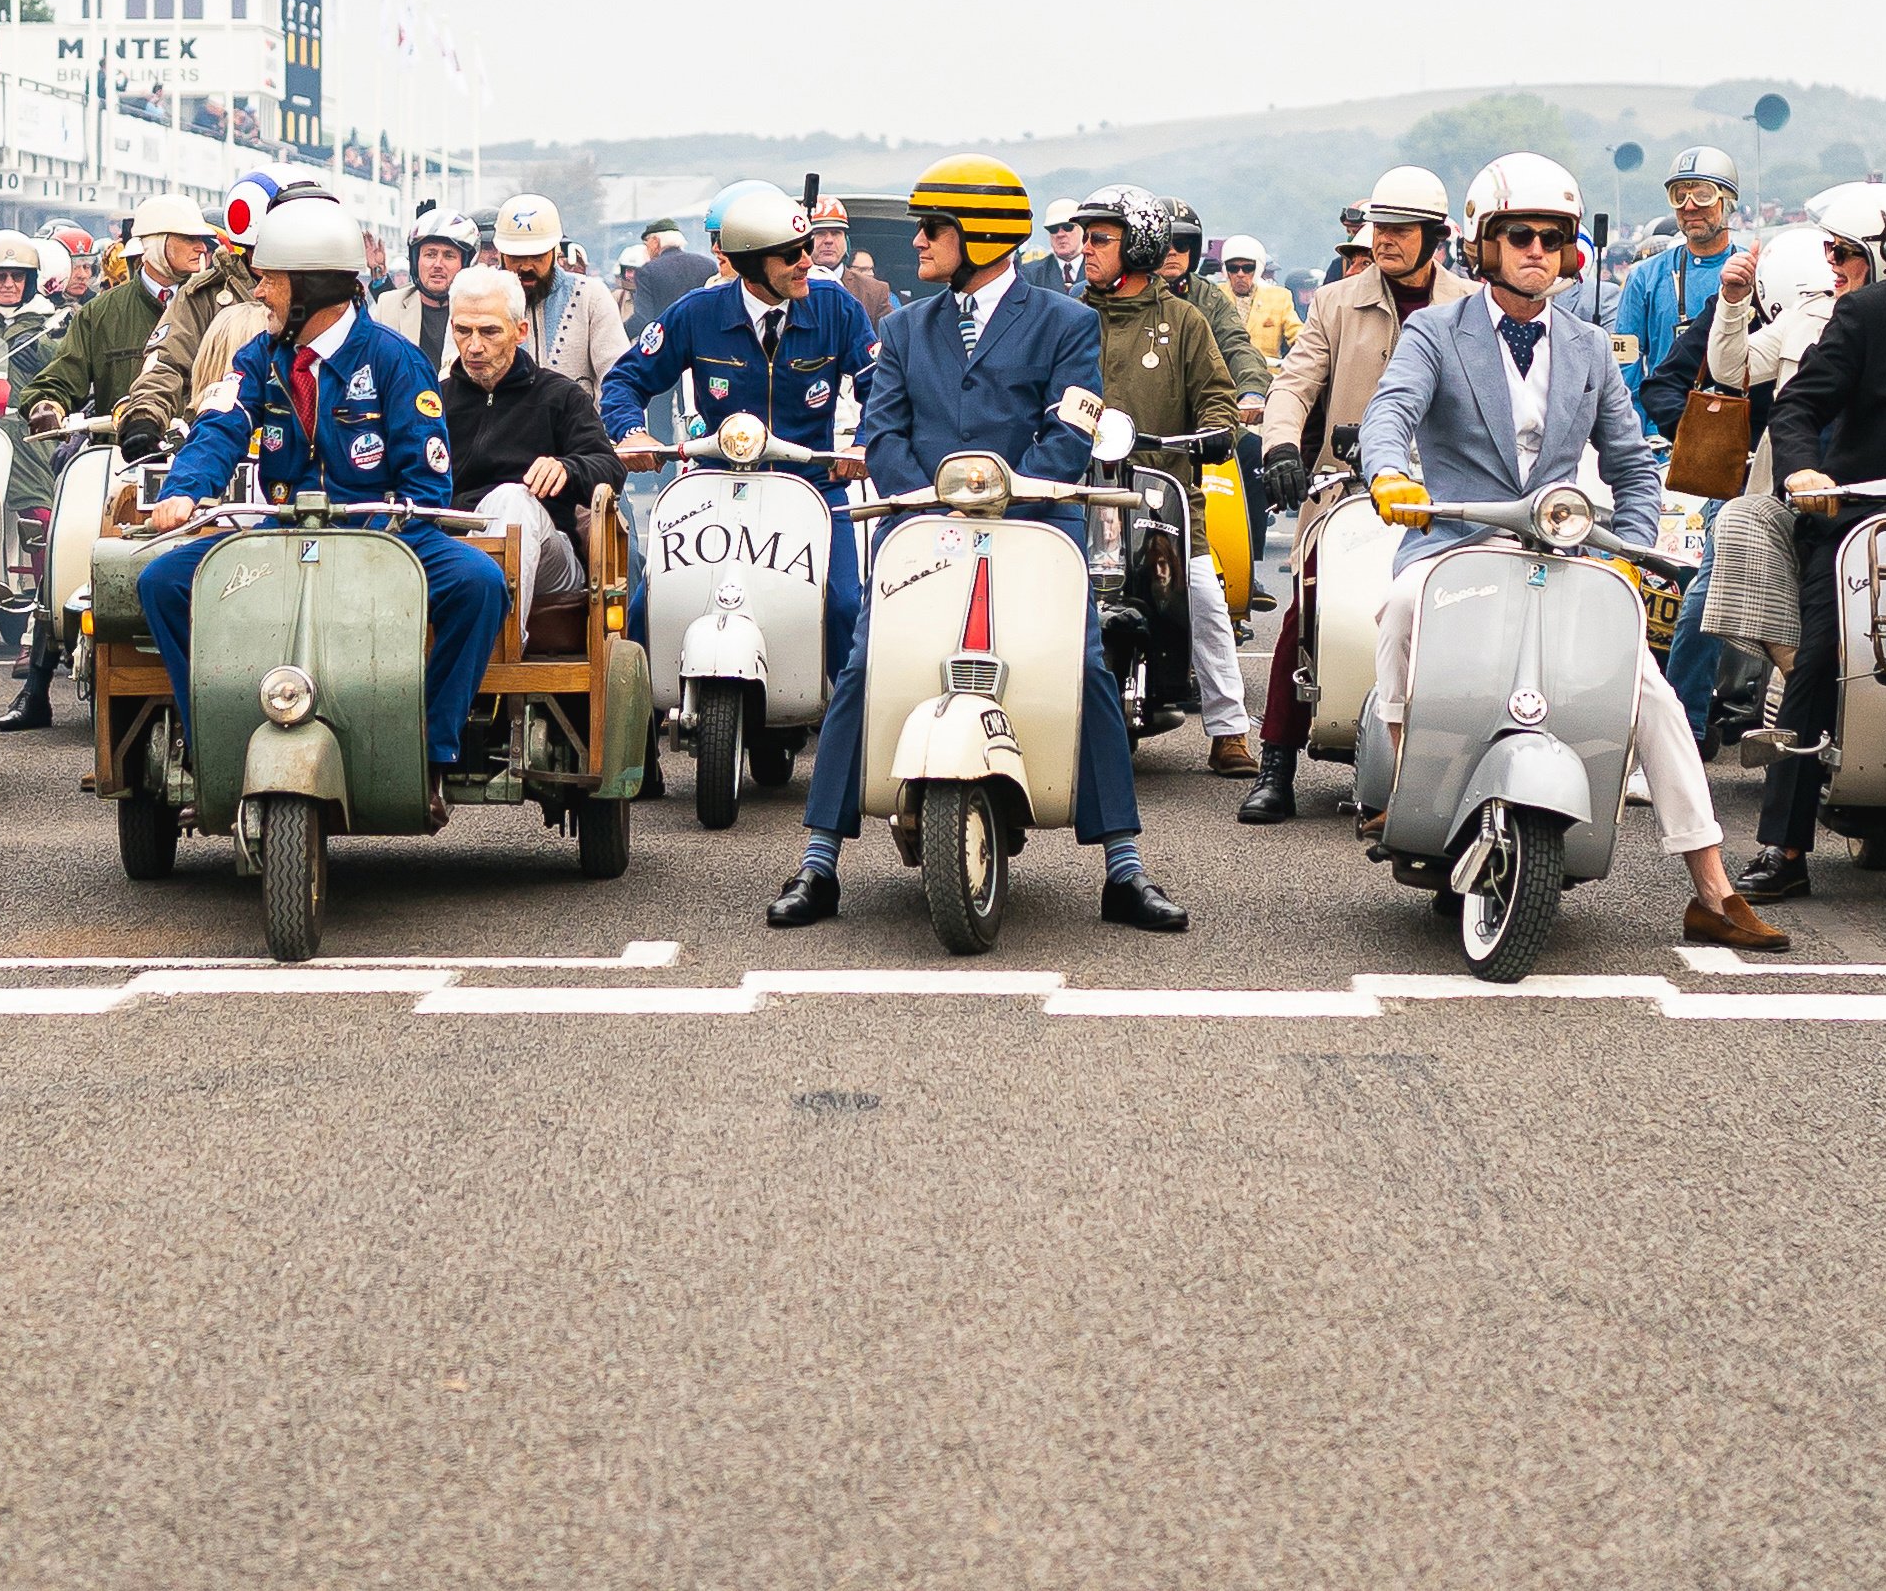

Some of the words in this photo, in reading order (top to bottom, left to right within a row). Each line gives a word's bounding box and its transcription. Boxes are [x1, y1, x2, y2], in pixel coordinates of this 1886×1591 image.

[58, 37, 198, 60] MNTEX
[77, 186, 97, 202] 12
[661, 524, 817, 586] ROMA
